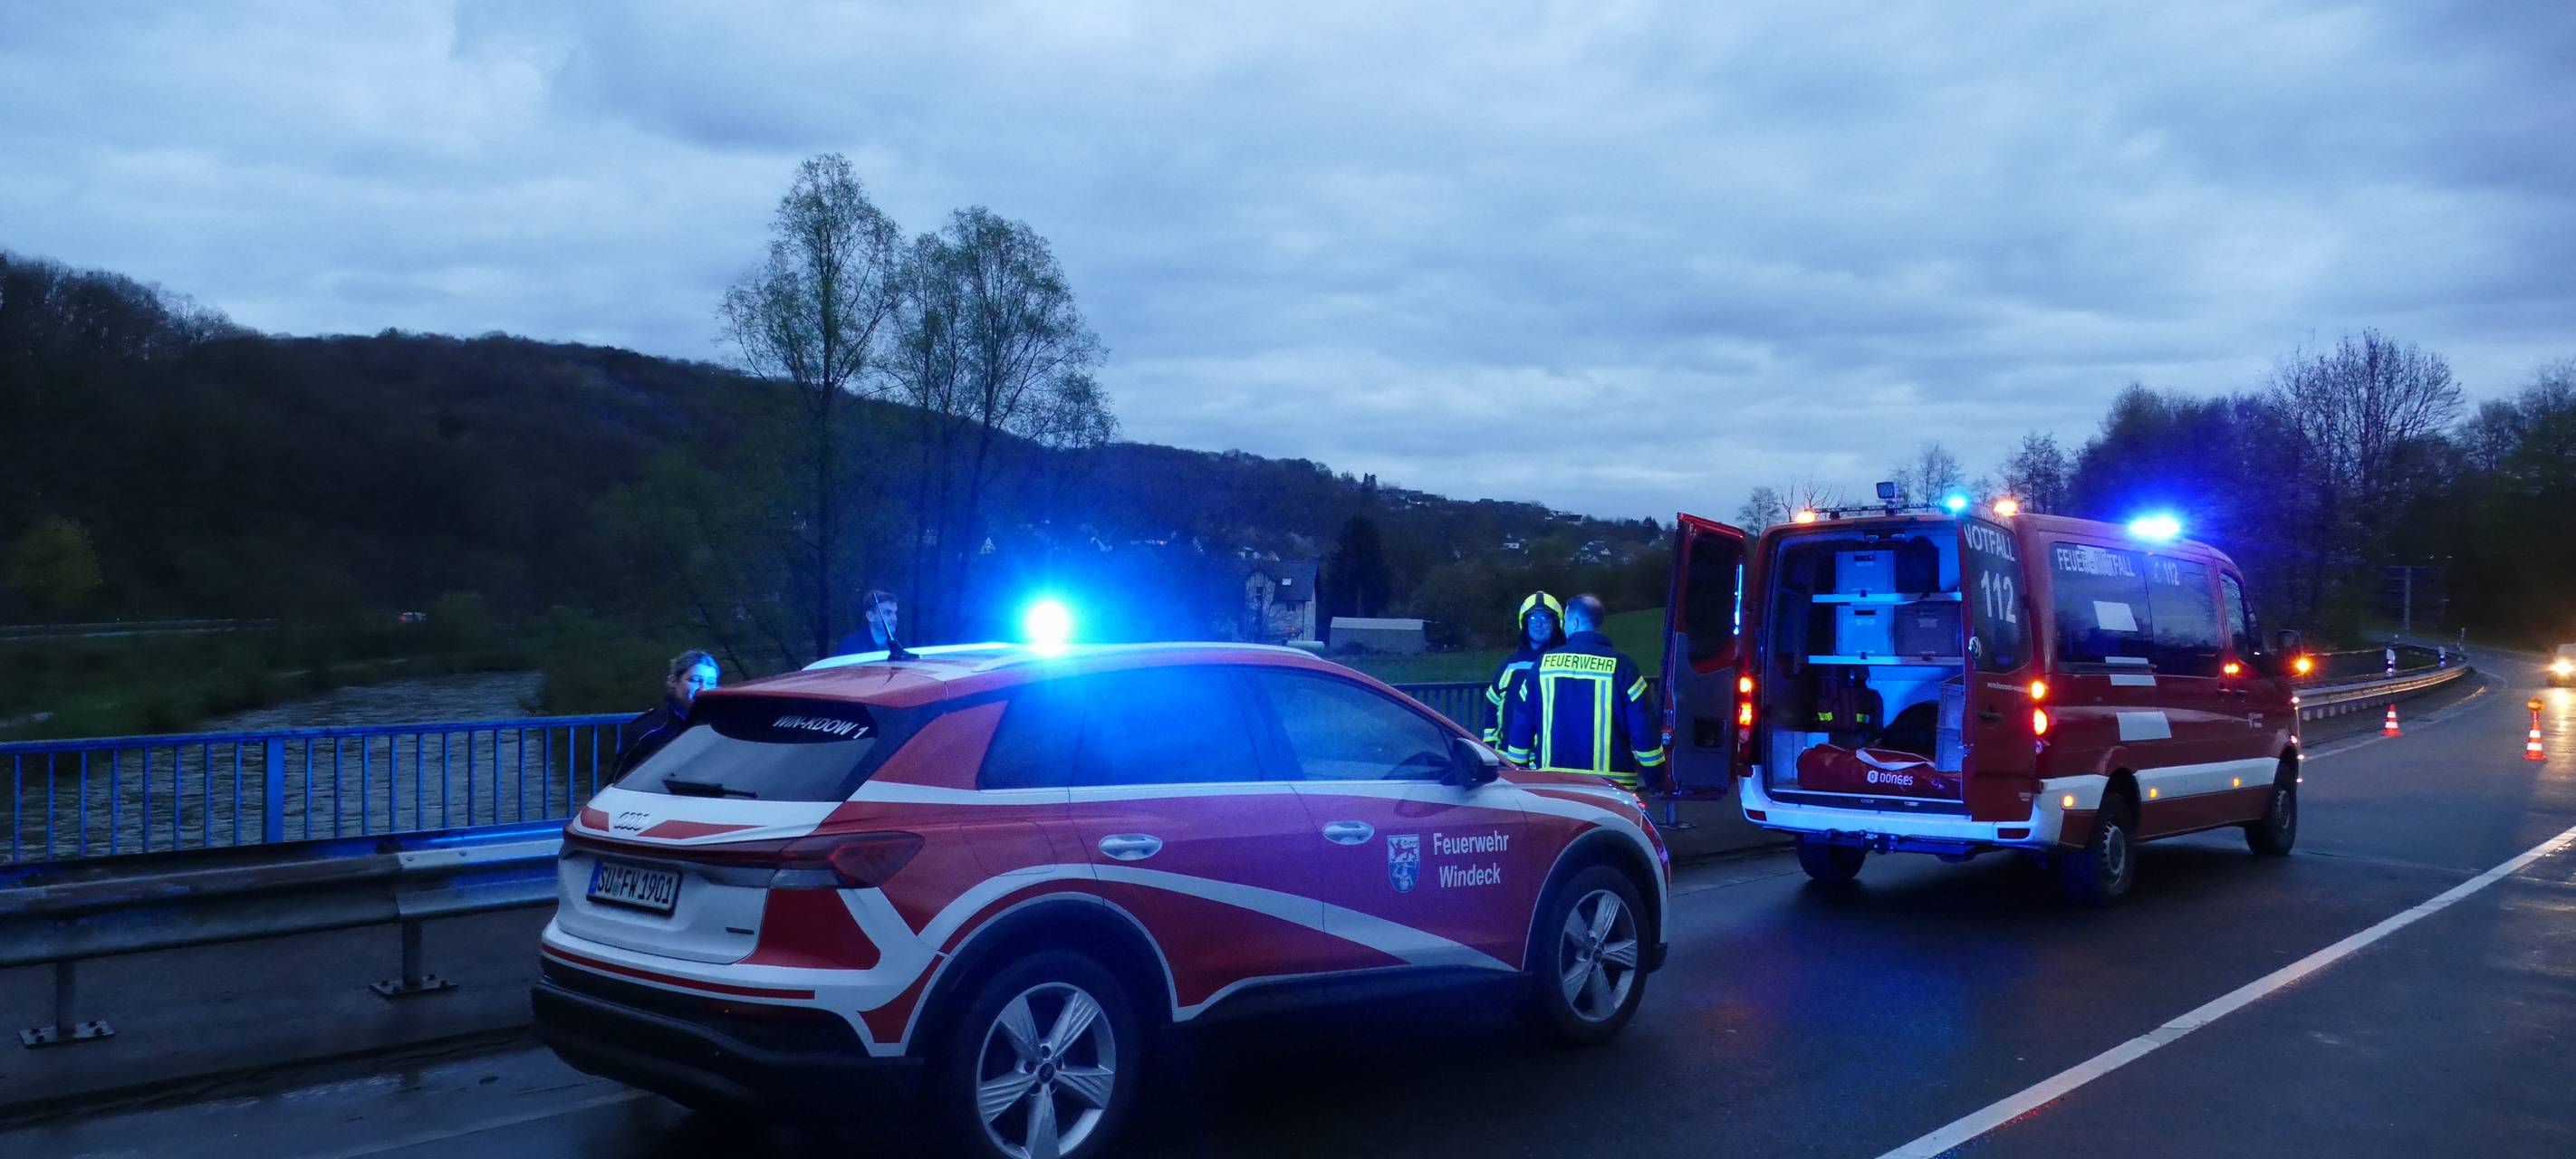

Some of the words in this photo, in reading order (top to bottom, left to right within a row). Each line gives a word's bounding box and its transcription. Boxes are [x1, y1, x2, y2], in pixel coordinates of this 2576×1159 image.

[1980, 570, 2016, 624] 112
[1543, 654, 1615, 672] FEUERWEHR
[852, 725, 870, 740] 1
[1433, 829, 1510, 856] Feuerwehr
[1438, 861, 1502, 888] Windeck
[637, 872, 674, 905] 1901
